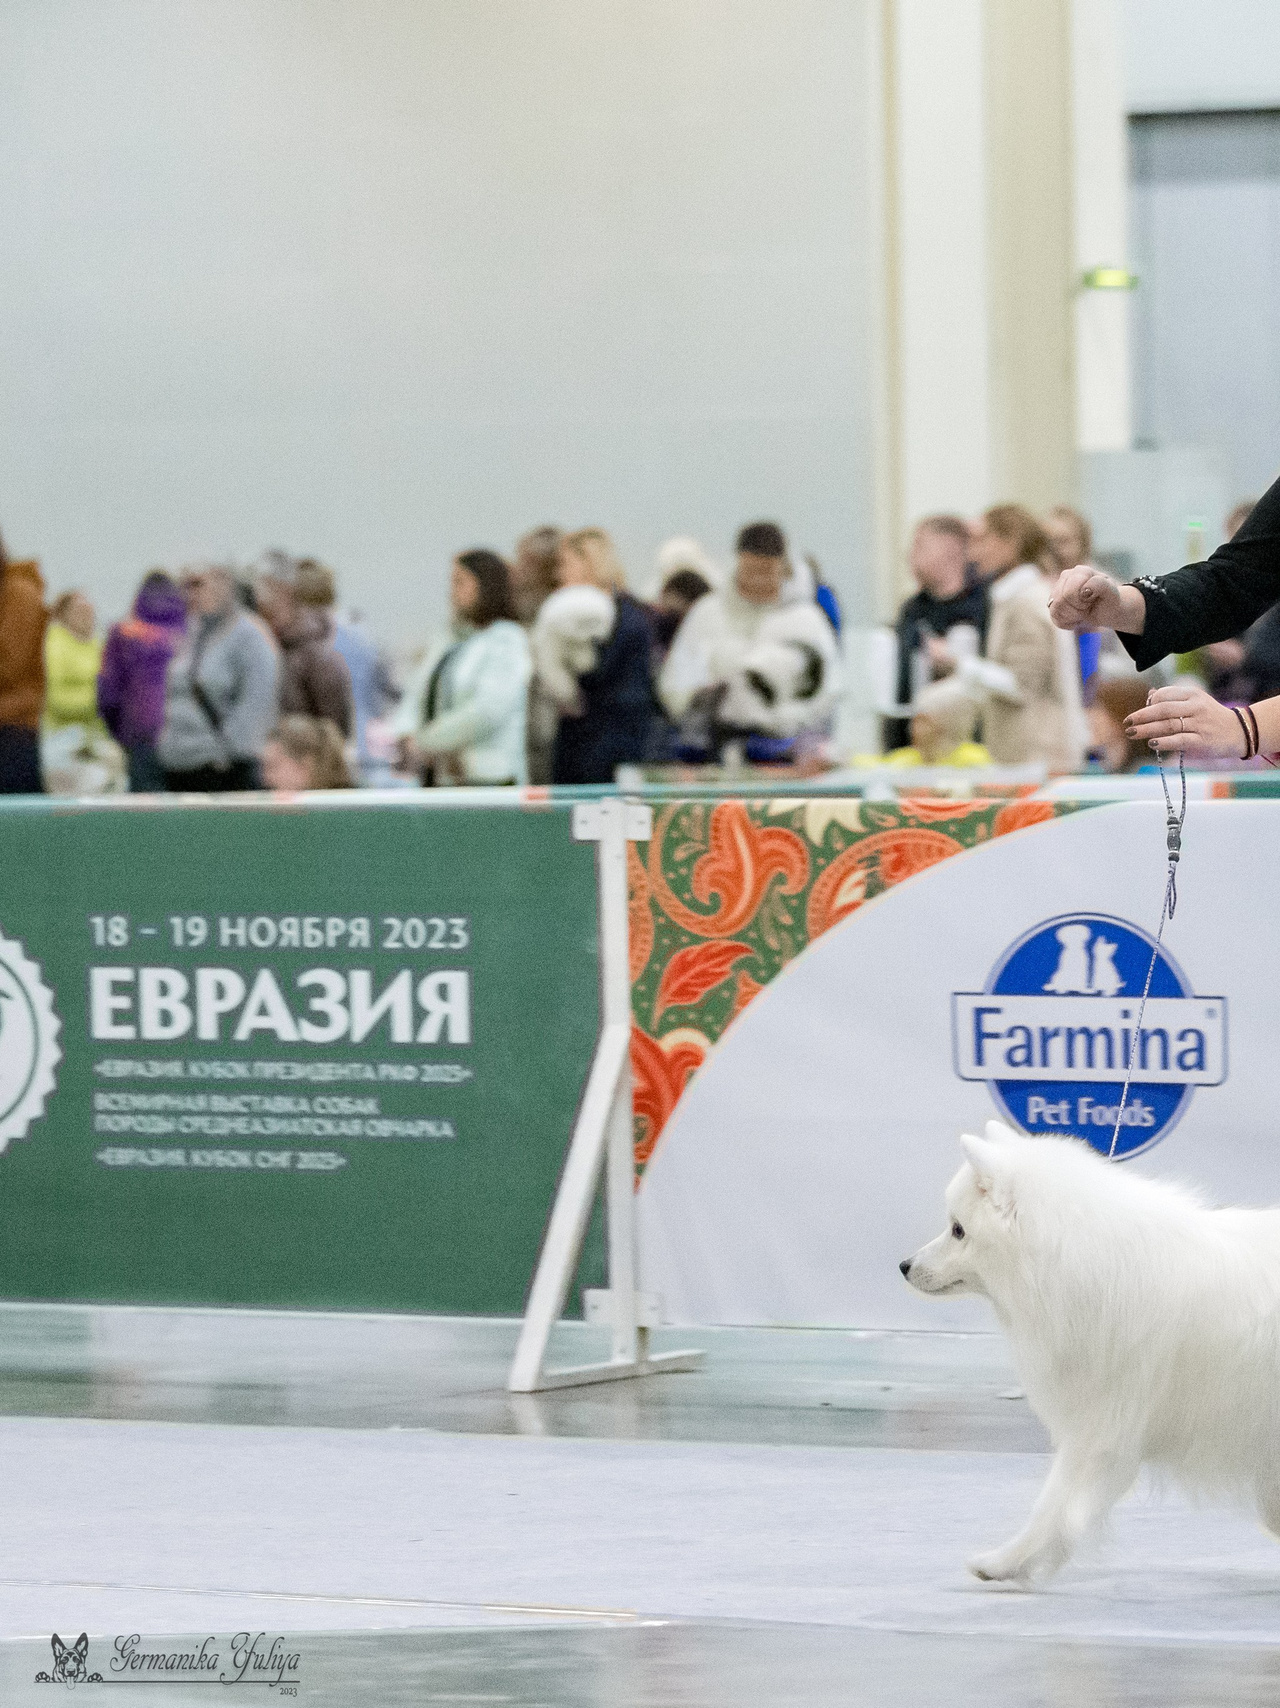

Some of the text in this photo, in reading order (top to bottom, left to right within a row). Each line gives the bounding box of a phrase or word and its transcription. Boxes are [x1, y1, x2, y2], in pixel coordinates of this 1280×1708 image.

[90, 916, 129, 946] 18
[170, 916, 208, 946] 19
[218, 916, 371, 948] НОЯБРЯ
[382, 917, 469, 949] 2023
[89, 966, 470, 1044] ЕВРАЗИЯ
[973, 1007, 1206, 1071] Farmina
[1027, 1096, 1155, 1127] Pet Foods
